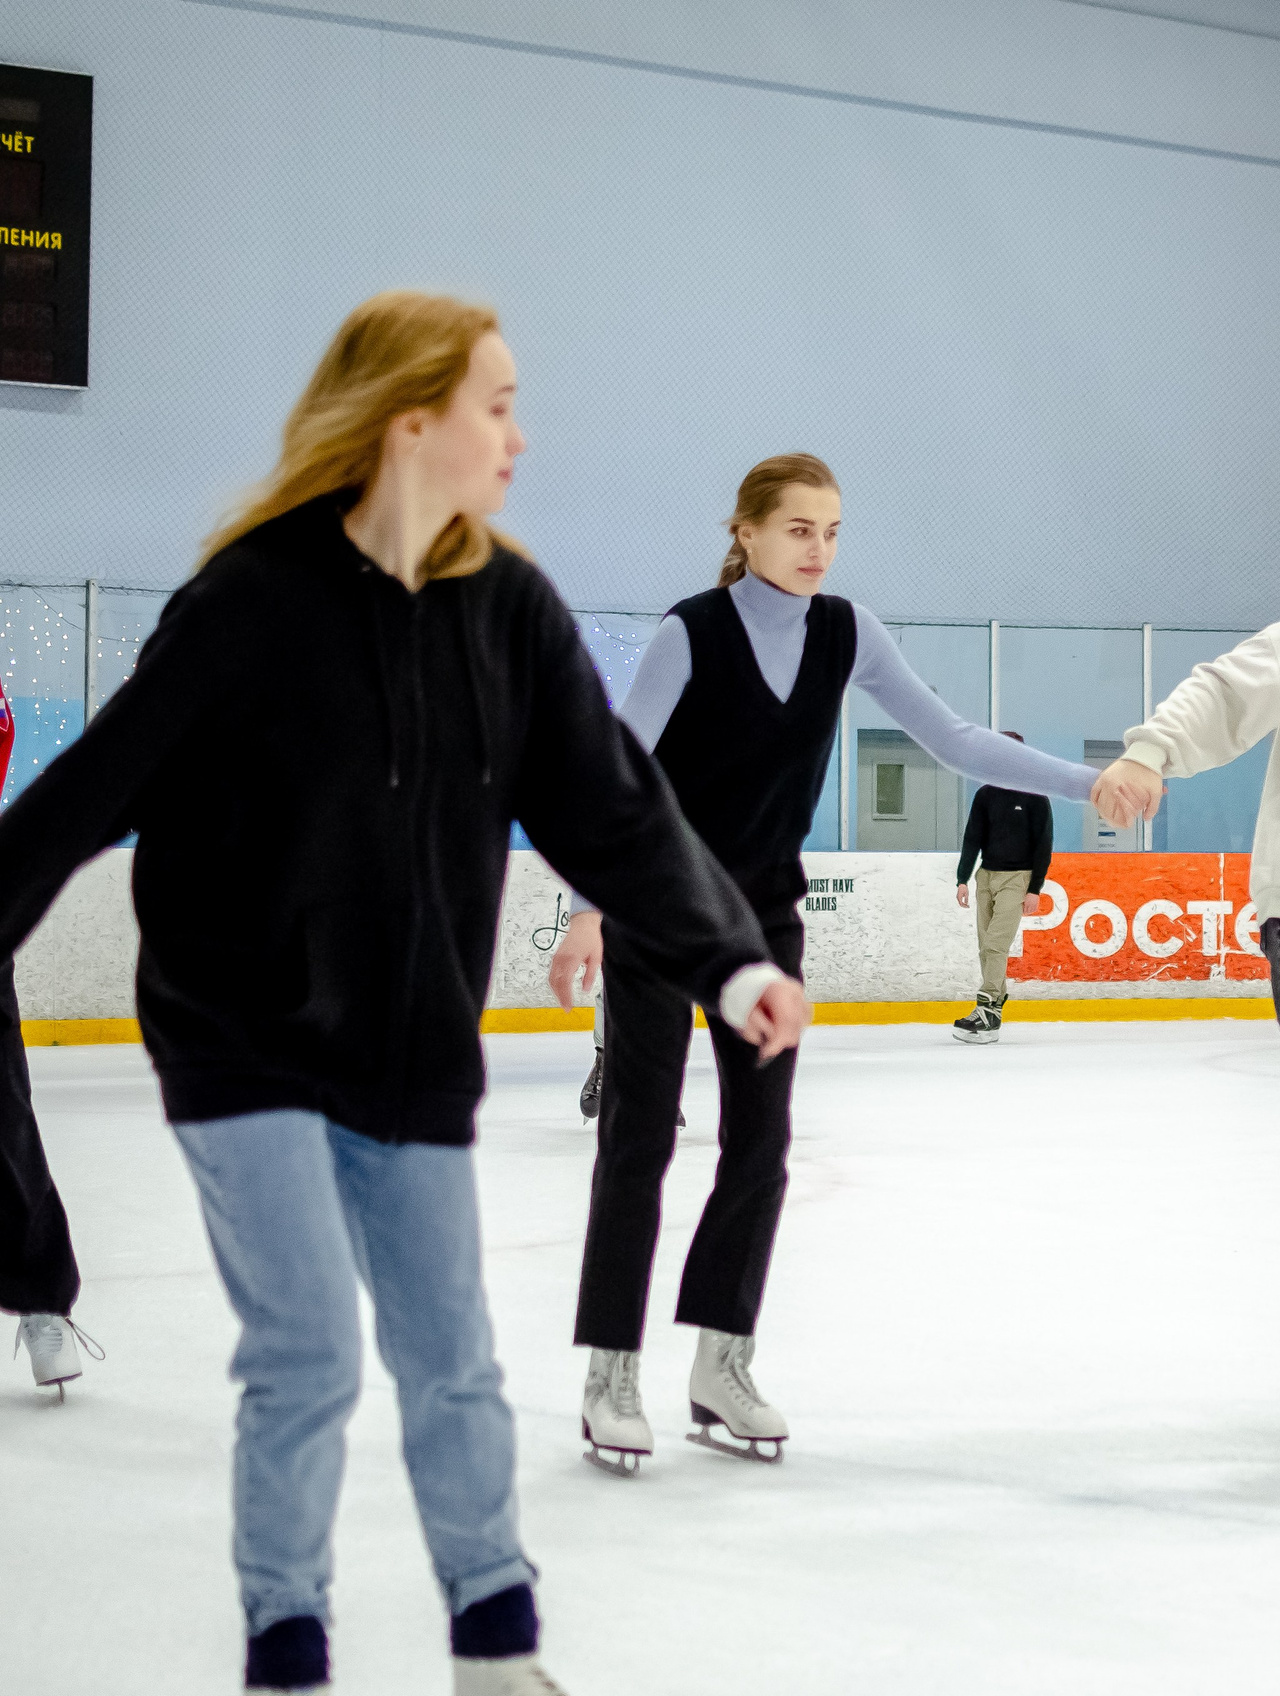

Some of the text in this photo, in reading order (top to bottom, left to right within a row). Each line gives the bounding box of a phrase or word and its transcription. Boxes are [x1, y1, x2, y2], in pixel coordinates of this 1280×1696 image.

[0, 130, 35, 153] ЧЁТ
[832, 878, 855, 893] HAVE
[805, 896, 837, 911] BLADES
